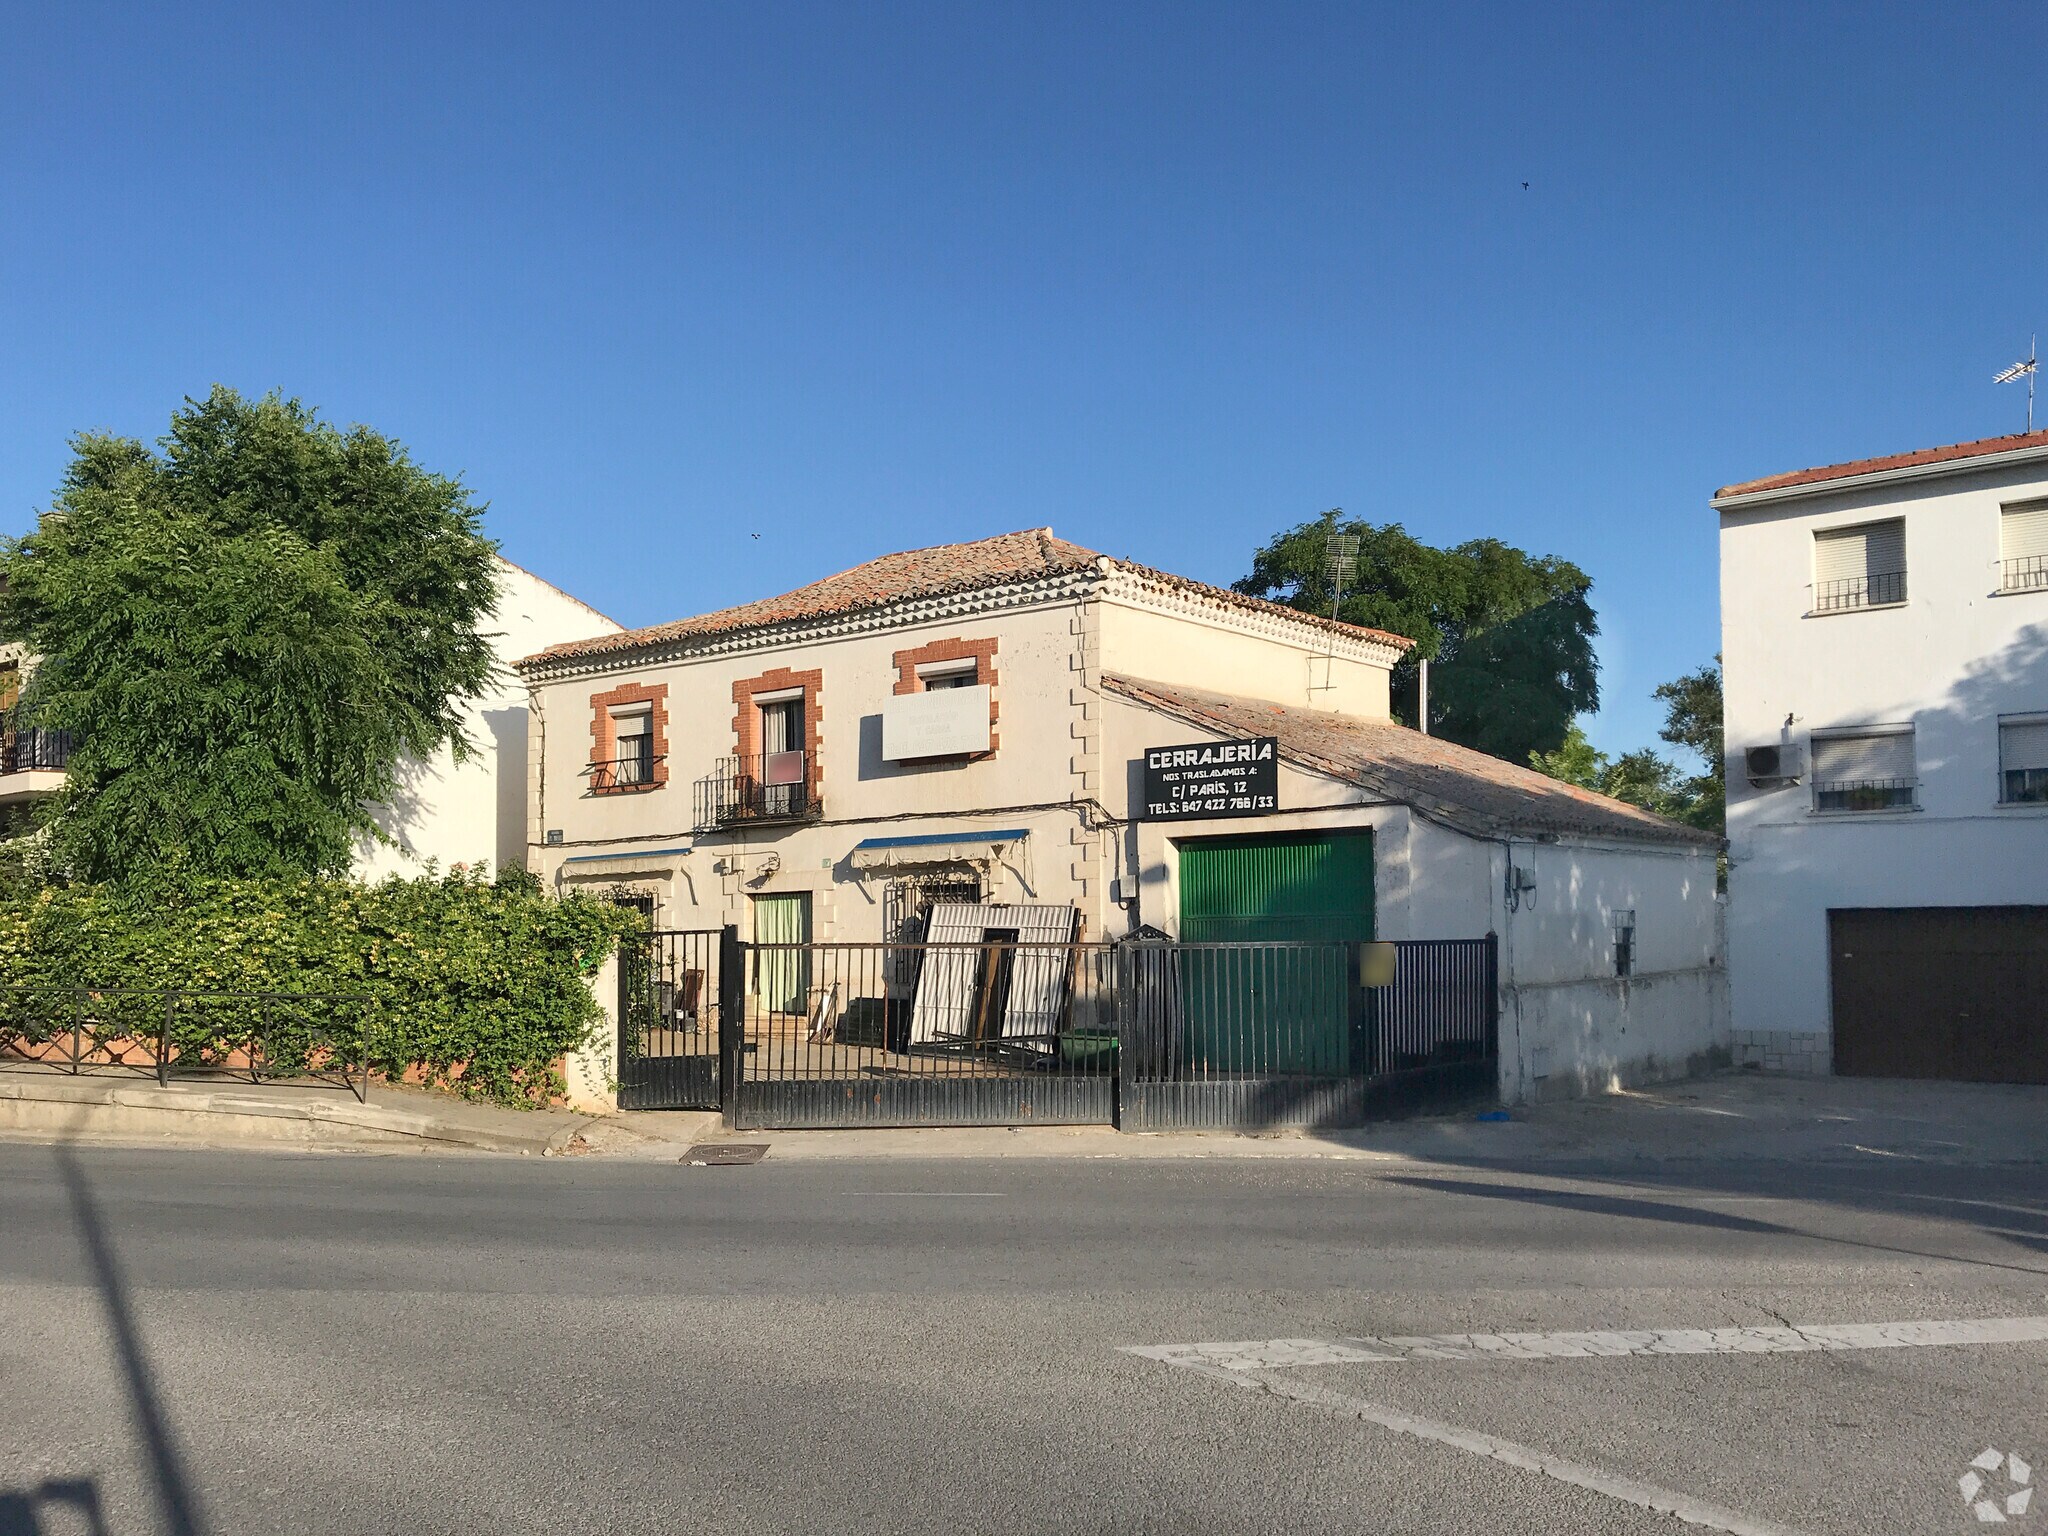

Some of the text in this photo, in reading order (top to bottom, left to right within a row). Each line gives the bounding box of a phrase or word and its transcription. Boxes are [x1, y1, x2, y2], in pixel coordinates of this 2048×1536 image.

[1149, 740, 1272, 769] CERRAJERÍA
[1162, 766, 1258, 782] NOS TRASLADAMOS A:
[1172, 781, 1247, 799] C/ PARÍS, 12
[1148, 802, 1180, 815] TELS:
[1182, 800, 1202, 813] 647
[1204, 798, 1226, 811] 422
